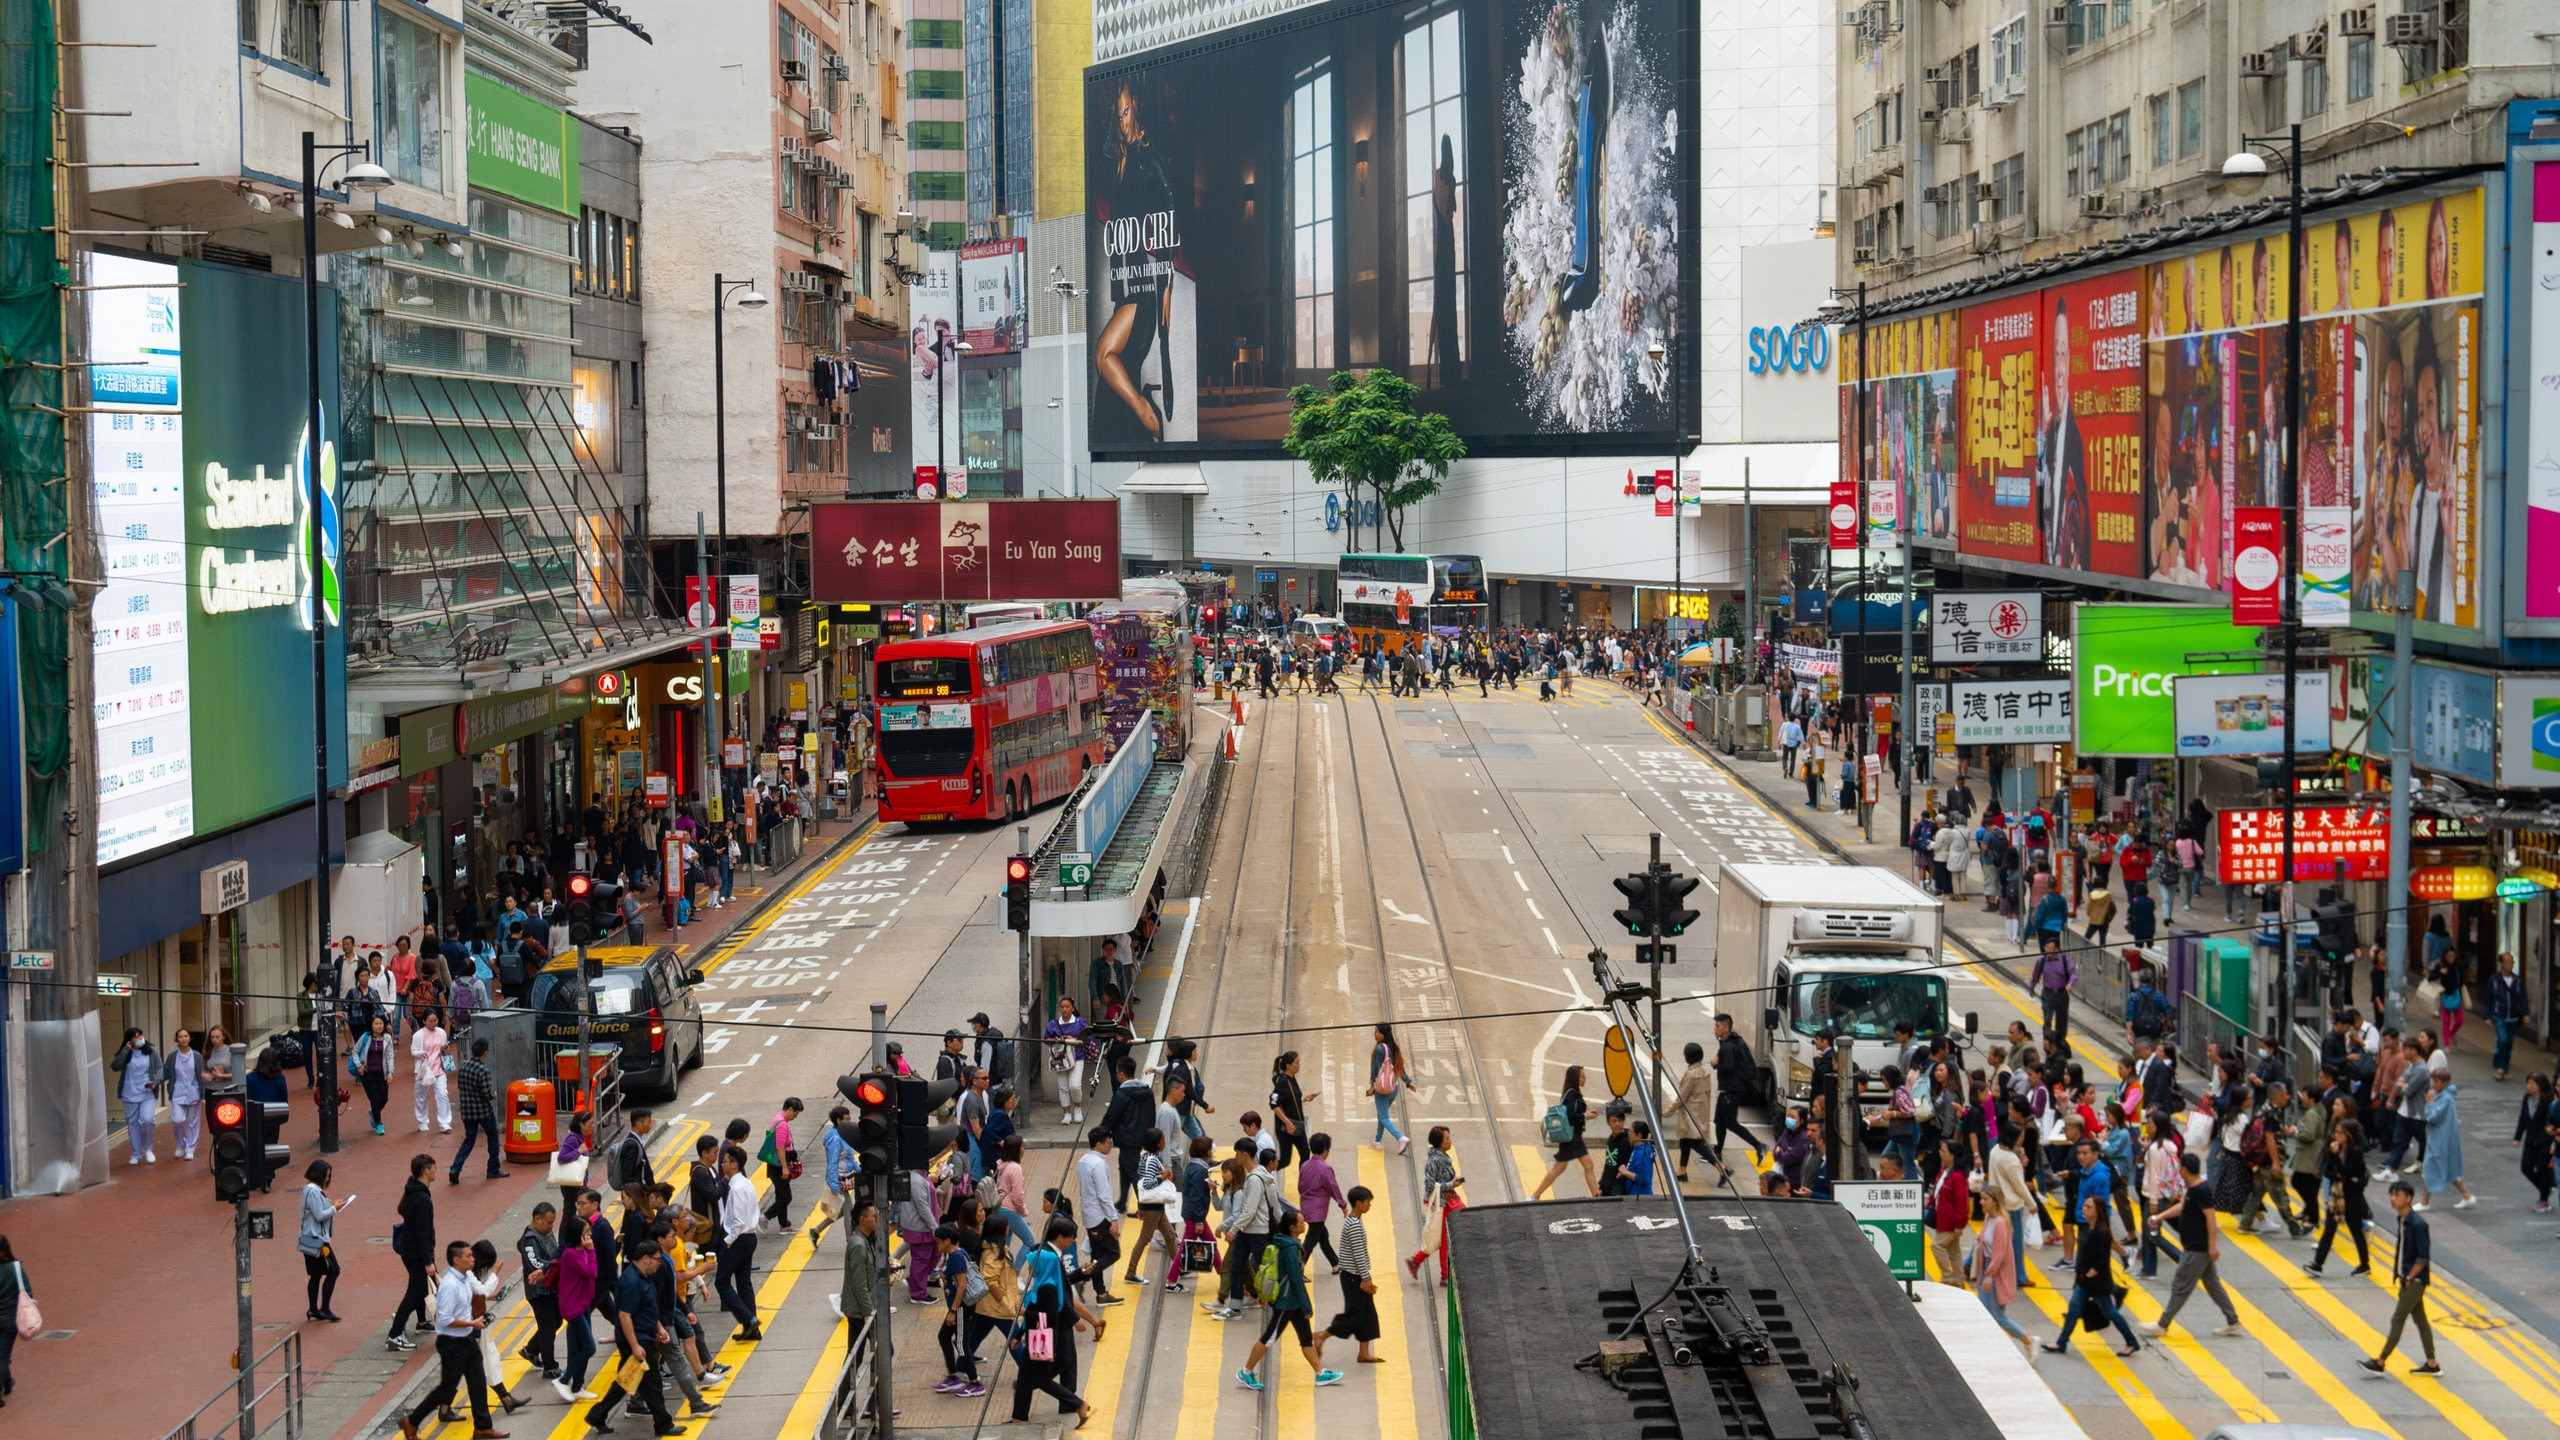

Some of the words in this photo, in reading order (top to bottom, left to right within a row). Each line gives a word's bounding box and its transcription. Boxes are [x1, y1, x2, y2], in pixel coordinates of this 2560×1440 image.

[490, 121, 514, 163] HANG
[515, 131, 538, 172] SENG
[539, 141, 561, 180] BANK
[1103, 217, 1140, 257] GOOD
[1142, 210, 1181, 252] GIRL
[1110, 264, 1142, 281] CAROLINA
[1143, 260, 1175, 278] HERRERA
[1130, 285, 1140, 294] NEW
[1142, 283, 1156, 292] YORK
[1748, 325, 1827, 374] SOGO
[2089, 434, 2141, 495] 11月23日
[206, 461, 293, 530] Standard
[1872, 502, 1894, 514] 香港
[842, 537, 920, 567] 余仁生
[1005, 541, 1023, 559] Eu
[1030, 541, 1057, 559] Yan
[1064, 540, 1102, 563] Sang
[2306, 545, 2347, 554] HONG
[2306, 555, 2347, 564] KONG
[200, 544, 296, 615] Chartered
[733, 599, 757, 611] 香港
[1670, 595, 1710, 620] KENZO
[1125, 647, 1136, 657] 77
[937, 685, 950, 697] 968
[626, 677, 641, 731] csl.
[504, 703, 520, 727] HANG
[1037, 755, 1073, 804] KMB
[1640, 770, 1729, 778] STOP
[1657, 777, 1729, 786] BUS
[941, 779, 970, 791] KMB
[1696, 816, 1788, 828] STOP
[1712, 827, 1796, 839] BUS
[2294, 830, 2323, 838] heung
[2331, 829, 2382, 837] Dispensary
[854, 838, 941, 856] 巴士
[842, 857, 911, 876] 站
[811, 877, 907, 892] BUS
[783, 892, 901, 909] STOP
[766, 909, 871, 932] 巴士
[754, 931, 837, 952] 站
[717, 956, 829, 974] BUS
[692, 971, 822, 992] STOP
[1867, 1189, 1917, 1201] 百德新街
